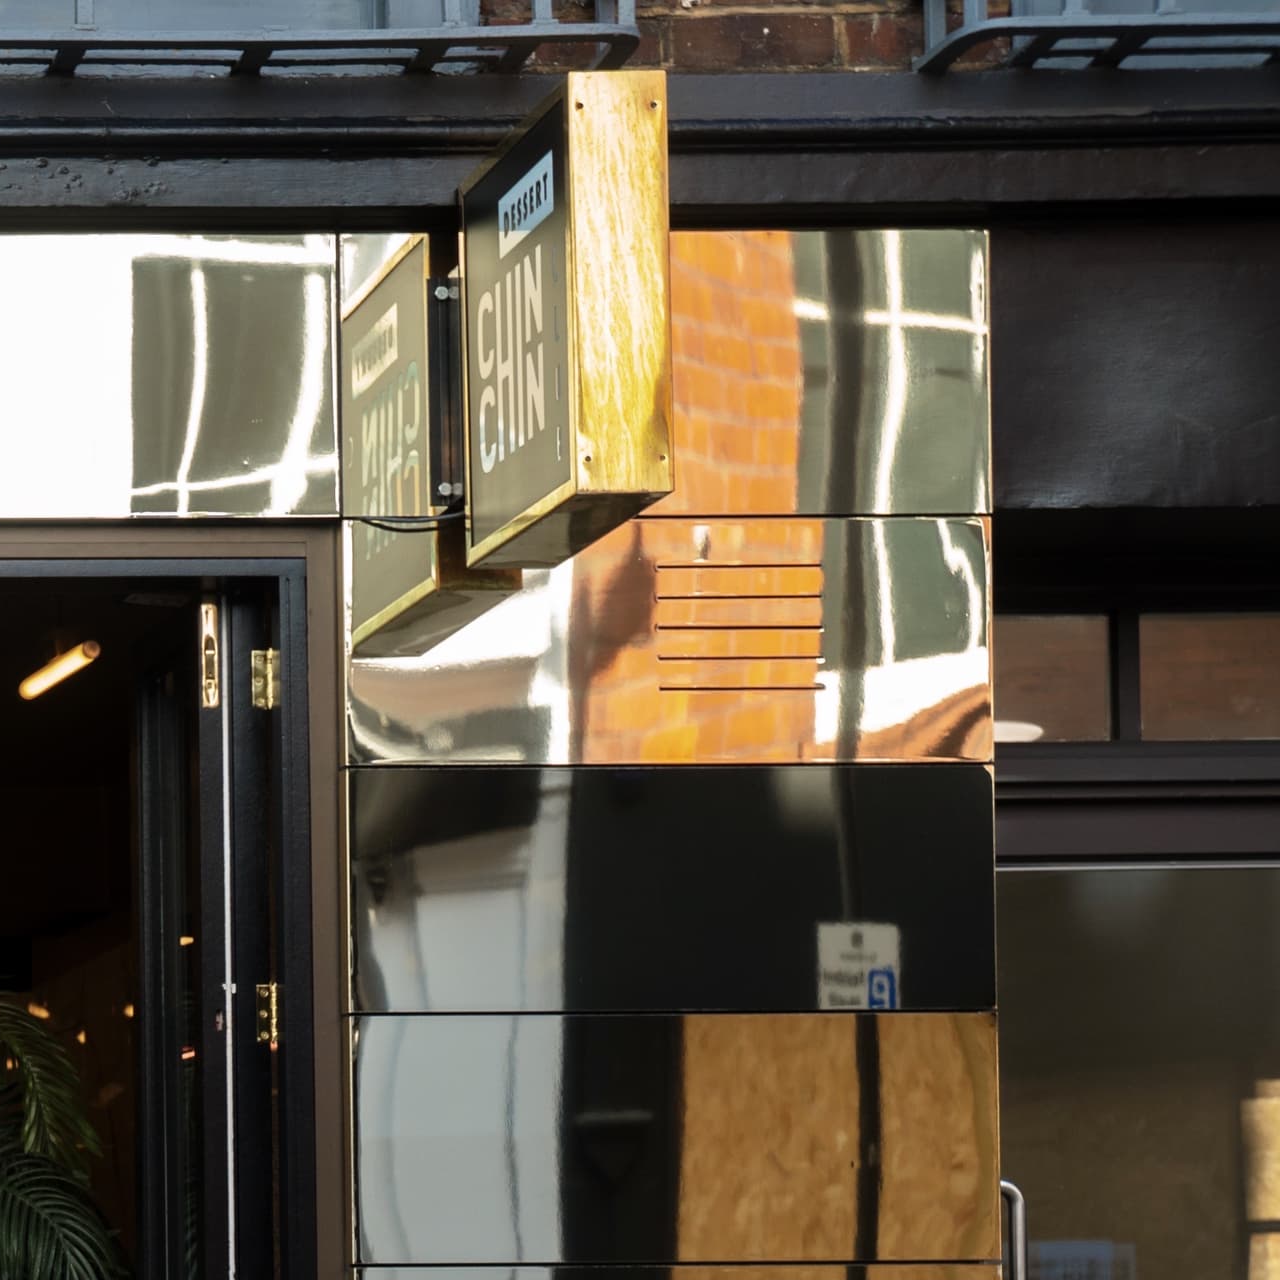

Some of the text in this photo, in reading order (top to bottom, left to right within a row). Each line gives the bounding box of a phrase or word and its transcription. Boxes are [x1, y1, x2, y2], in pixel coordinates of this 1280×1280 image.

[502, 171, 548, 239] DESSERT
[477, 243, 543, 380] CHIN
[479, 342, 545, 474] CHIN
